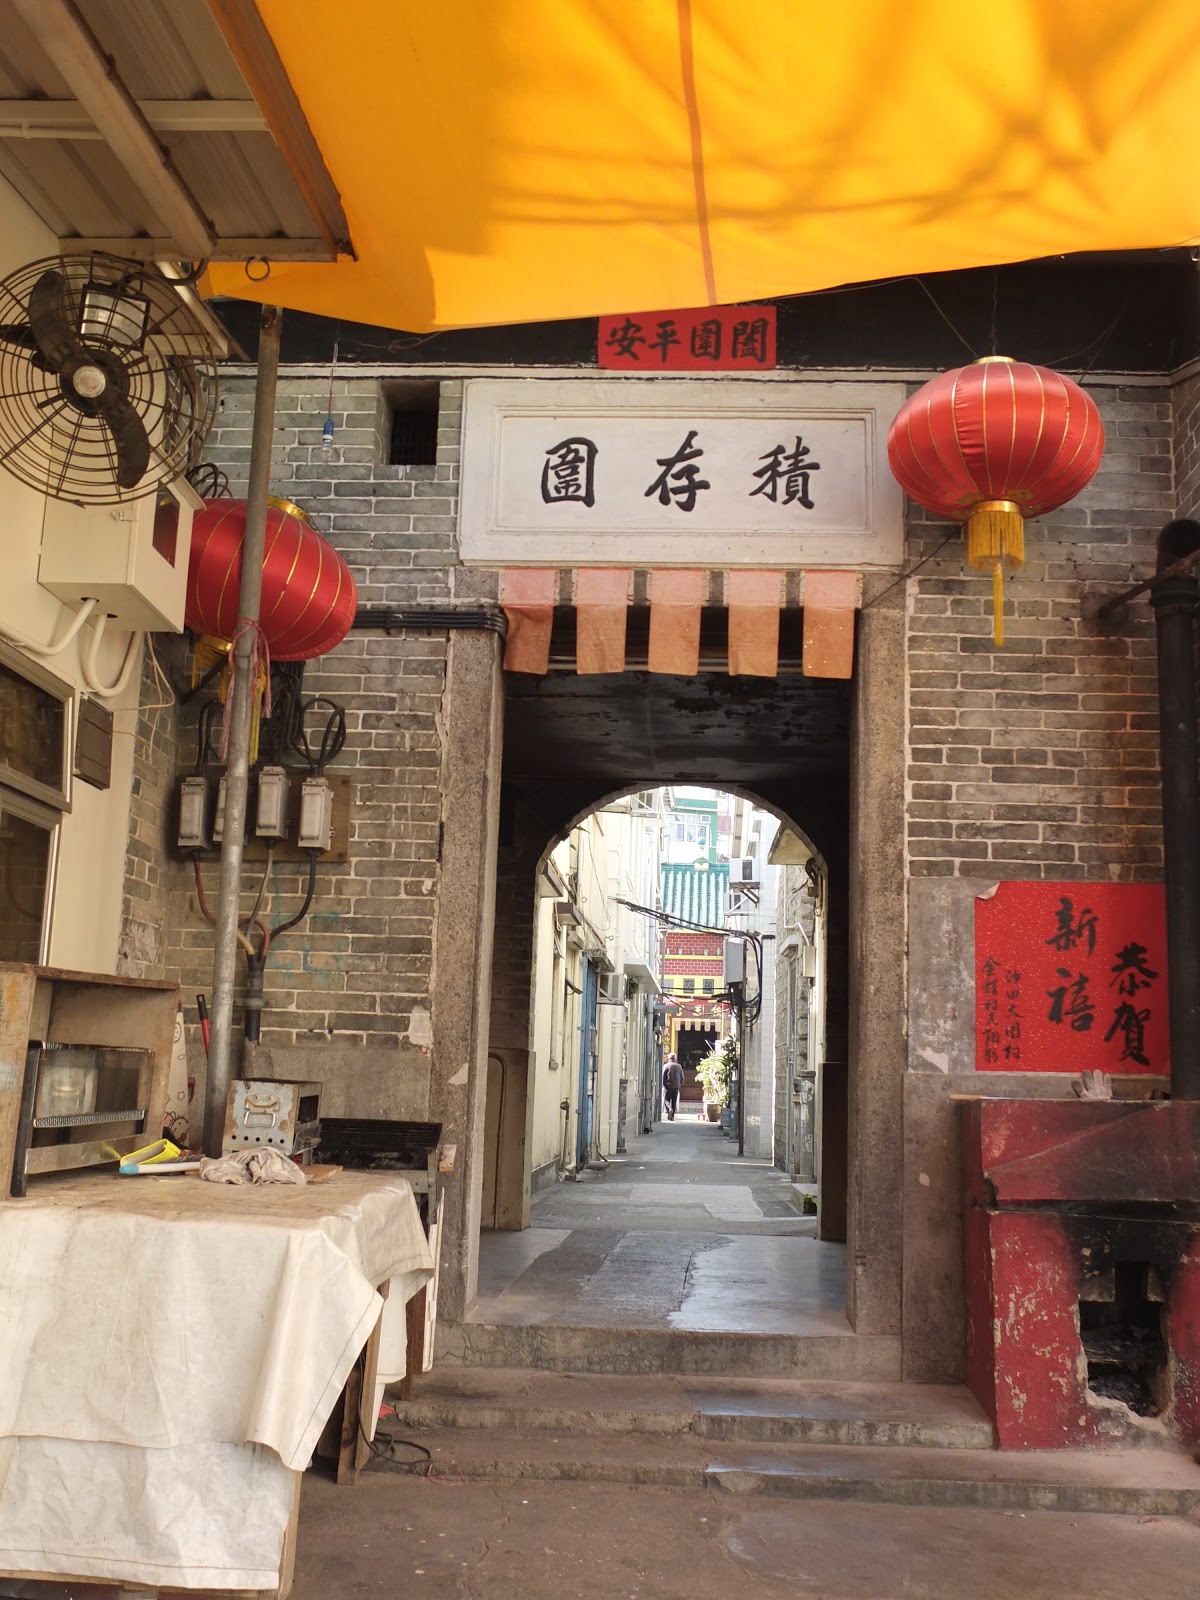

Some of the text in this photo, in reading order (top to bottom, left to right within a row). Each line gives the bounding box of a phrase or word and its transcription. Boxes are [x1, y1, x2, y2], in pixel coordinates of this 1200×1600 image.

[606, 317, 769, 363] 闔圍平安
[541, 430, 820, 511] 積存圍
[1045, 897, 1099, 1031] 新禧
[1104, 942, 1159, 1066] 恭賀
